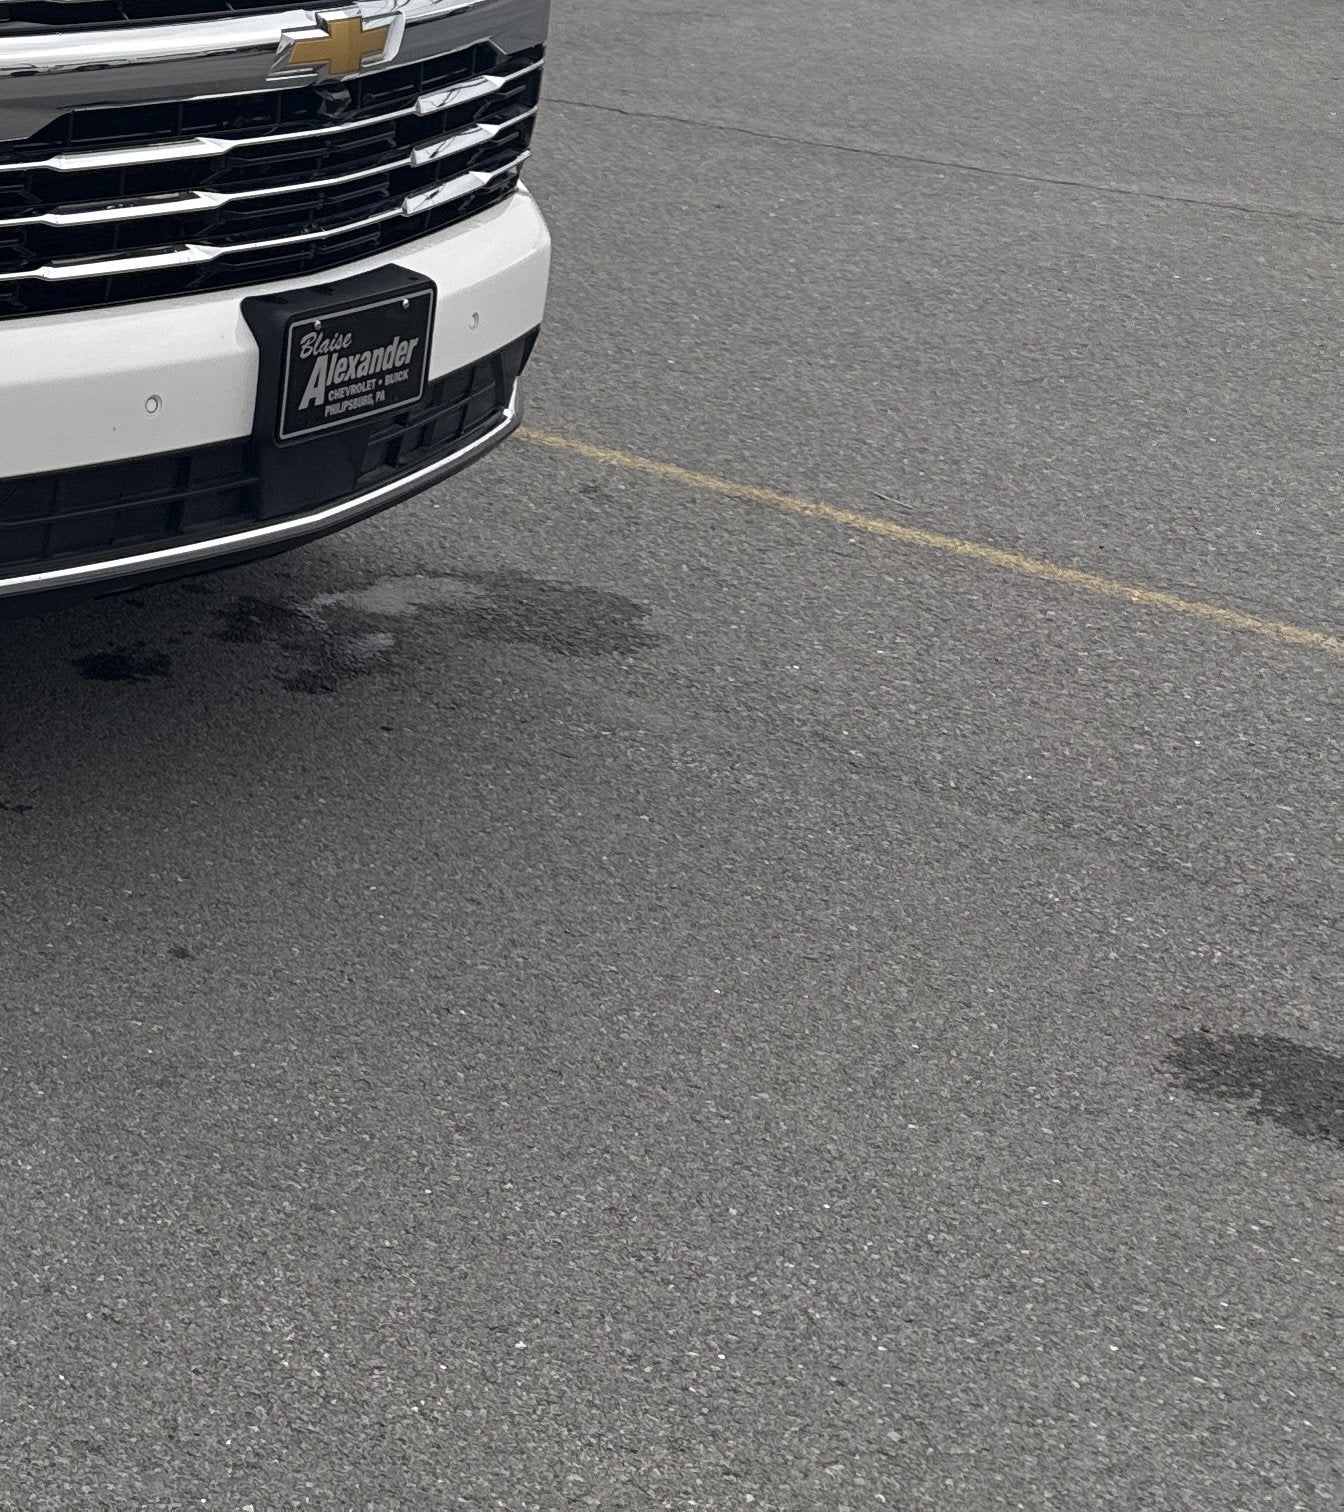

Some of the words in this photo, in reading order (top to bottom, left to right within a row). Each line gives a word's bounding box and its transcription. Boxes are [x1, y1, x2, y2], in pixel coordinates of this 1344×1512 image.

[299, 331, 352, 359] Blaise
[298, 336, 419, 410] Alexander
[328, 378, 377, 402] CHEVROLET
[384, 369, 409, 386] BUICK
[375, 389, 386, 403] PA
